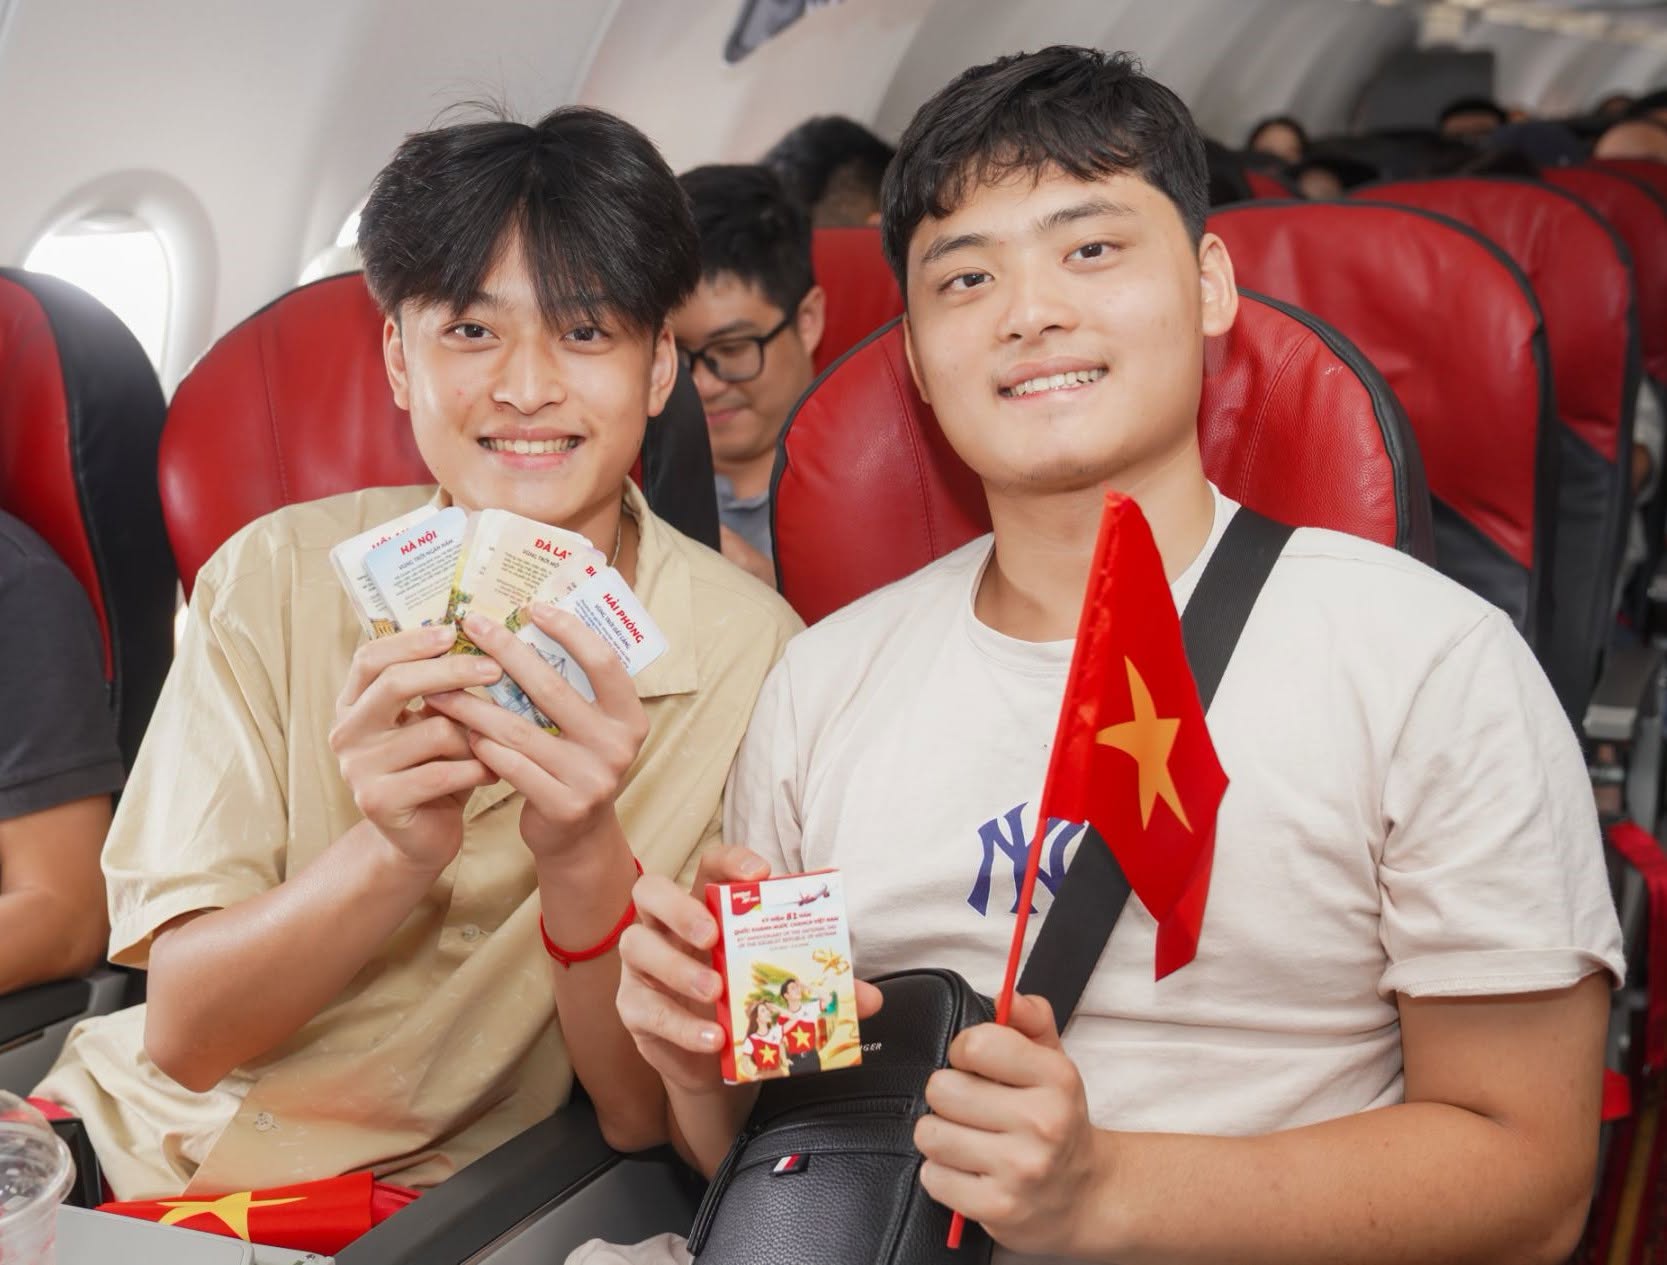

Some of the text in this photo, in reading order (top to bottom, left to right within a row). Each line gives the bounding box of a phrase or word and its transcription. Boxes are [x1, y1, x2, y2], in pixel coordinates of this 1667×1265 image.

[400, 539, 417, 555] HÀ
[417, 530, 438, 546] NỘI
[534, 538, 551, 552] ĐÀ
[603, 593, 620, 611] HẢI
[616, 609, 645, 644] PHÒNG
